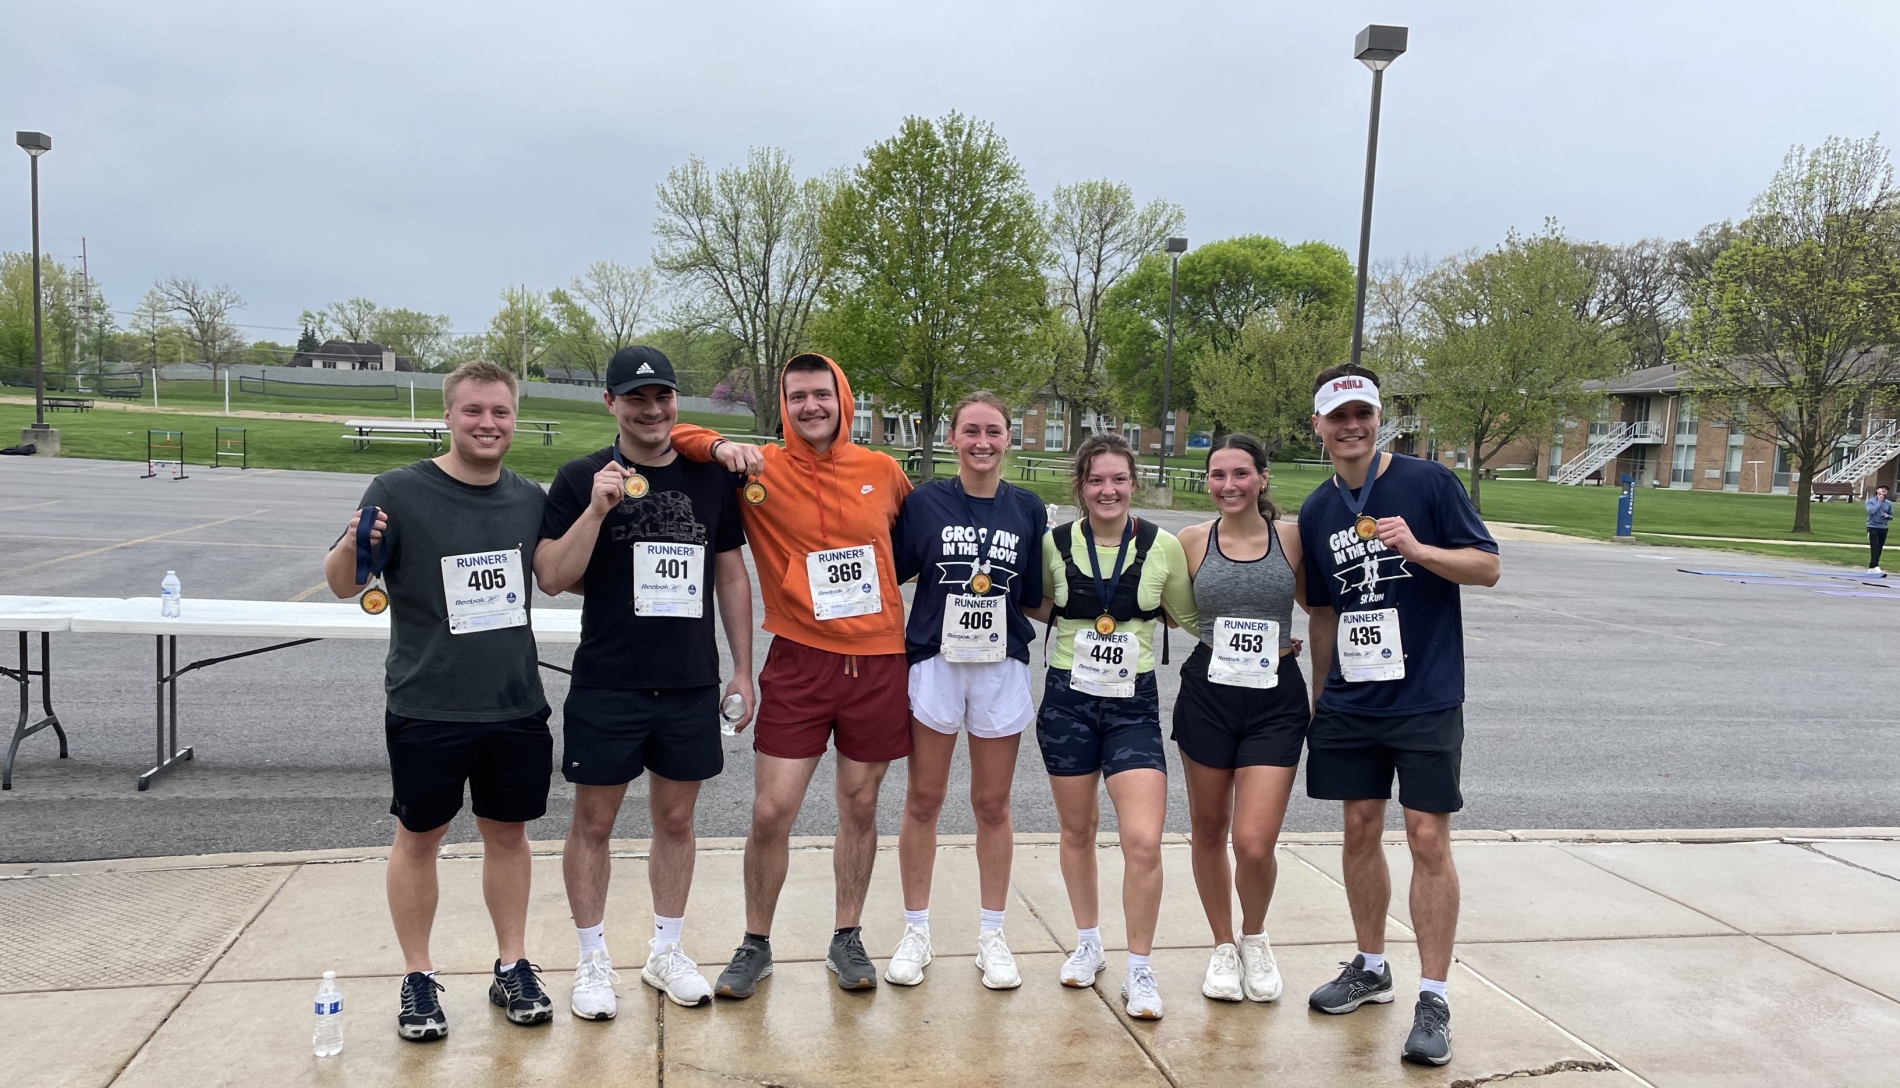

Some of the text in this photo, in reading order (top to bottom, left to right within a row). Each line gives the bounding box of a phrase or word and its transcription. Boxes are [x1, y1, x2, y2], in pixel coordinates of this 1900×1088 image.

[1333, 380, 1363, 392] NIU
[611, 520, 706, 542] CALIBER
[648, 545, 694, 556] RUNNERS
[818, 549, 864, 563] RUNNERS
[942, 542, 1018, 564] IN THE ROVE
[1334, 550, 1348, 566] IN
[1346, 542, 1366, 560] THE
[456, 554, 508, 568] RUNNERS
[655, 558, 688, 580] 401
[468, 568, 506, 591] 405
[828, 562, 862, 584] 366
[456, 597, 484, 606] Reebok
[954, 598, 998, 608] RUNNERS
[1368, 592, 1384, 602] RUN
[960, 612, 992, 630] 406
[1224, 620, 1268, 630] RUNNERS
[1344, 612, 1384, 624] RUNNERS
[1086, 631, 1128, 643] RUNNERS
[1230, 633, 1264, 653] 453
[1350, 626, 1382, 646] 435
[1090, 644, 1124, 664] 448
